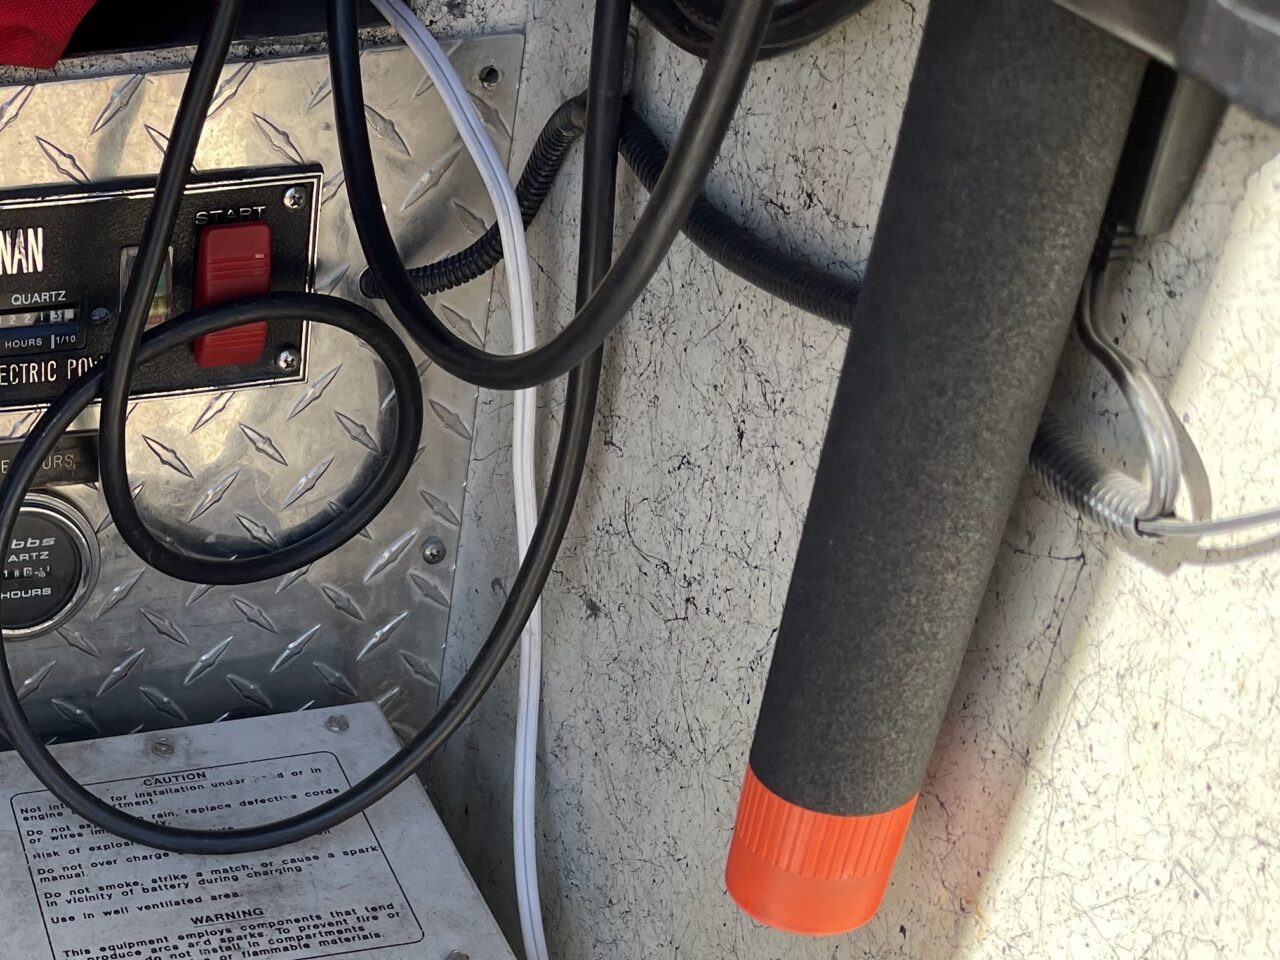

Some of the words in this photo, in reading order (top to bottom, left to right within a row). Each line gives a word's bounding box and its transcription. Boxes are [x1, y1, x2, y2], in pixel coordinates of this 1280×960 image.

[196, 206, 266, 224] START
[12, 291, 66, 305] QUARTZ
[5, 338, 42, 348] HOURS
[8, 551, 49, 562] ARTZ
[1, 588, 51, 599] HOURS
[143, 772, 206, 786] CAUTION
[20, 806, 41, 814] Not
[135, 785, 204, 798] installation
[305, 788, 339, 797] cords
[23, 809, 63, 821] engine
[50, 832, 83, 840] wires
[33, 851, 60, 859] Risk
[62, 864, 82, 872] not
[126, 850, 169, 862] charge
[40, 871, 88, 883] manual.
[70, 887, 90, 895] not
[98, 881, 143, 891] smoke,
[152, 874, 187, 883] strike
[211, 864, 253, 875] match,
[282, 856, 319, 864] cause
[343, 846, 378, 856] spark
[66, 893, 112, 904] vicinity
[122, 888, 133, 896] of
[142, 882, 188, 893] battery
[198, 873, 239, 885] during
[51, 916, 75, 924] Use
[103, 907, 128, 916] well
[137, 896, 202, 911] ventilated
[211, 892, 243, 900] area.
[190, 908, 264, 924] WARNING
[63, 949, 90, 957] This
[100, 936, 169, 953] equipment
[178, 928, 232, 940] employs
[240, 915, 322, 931] components
[330, 908, 357, 918] that
[365, 903, 394, 912] tend
[151, 945, 179, 953] arcs
[298, 918, 348, 933] prevent
[170, 951, 191, 959] not
[268, 926, 365, 944] compartments
[242, 942, 310, 958] flammable
[319, 932, 384, 946] materials.
